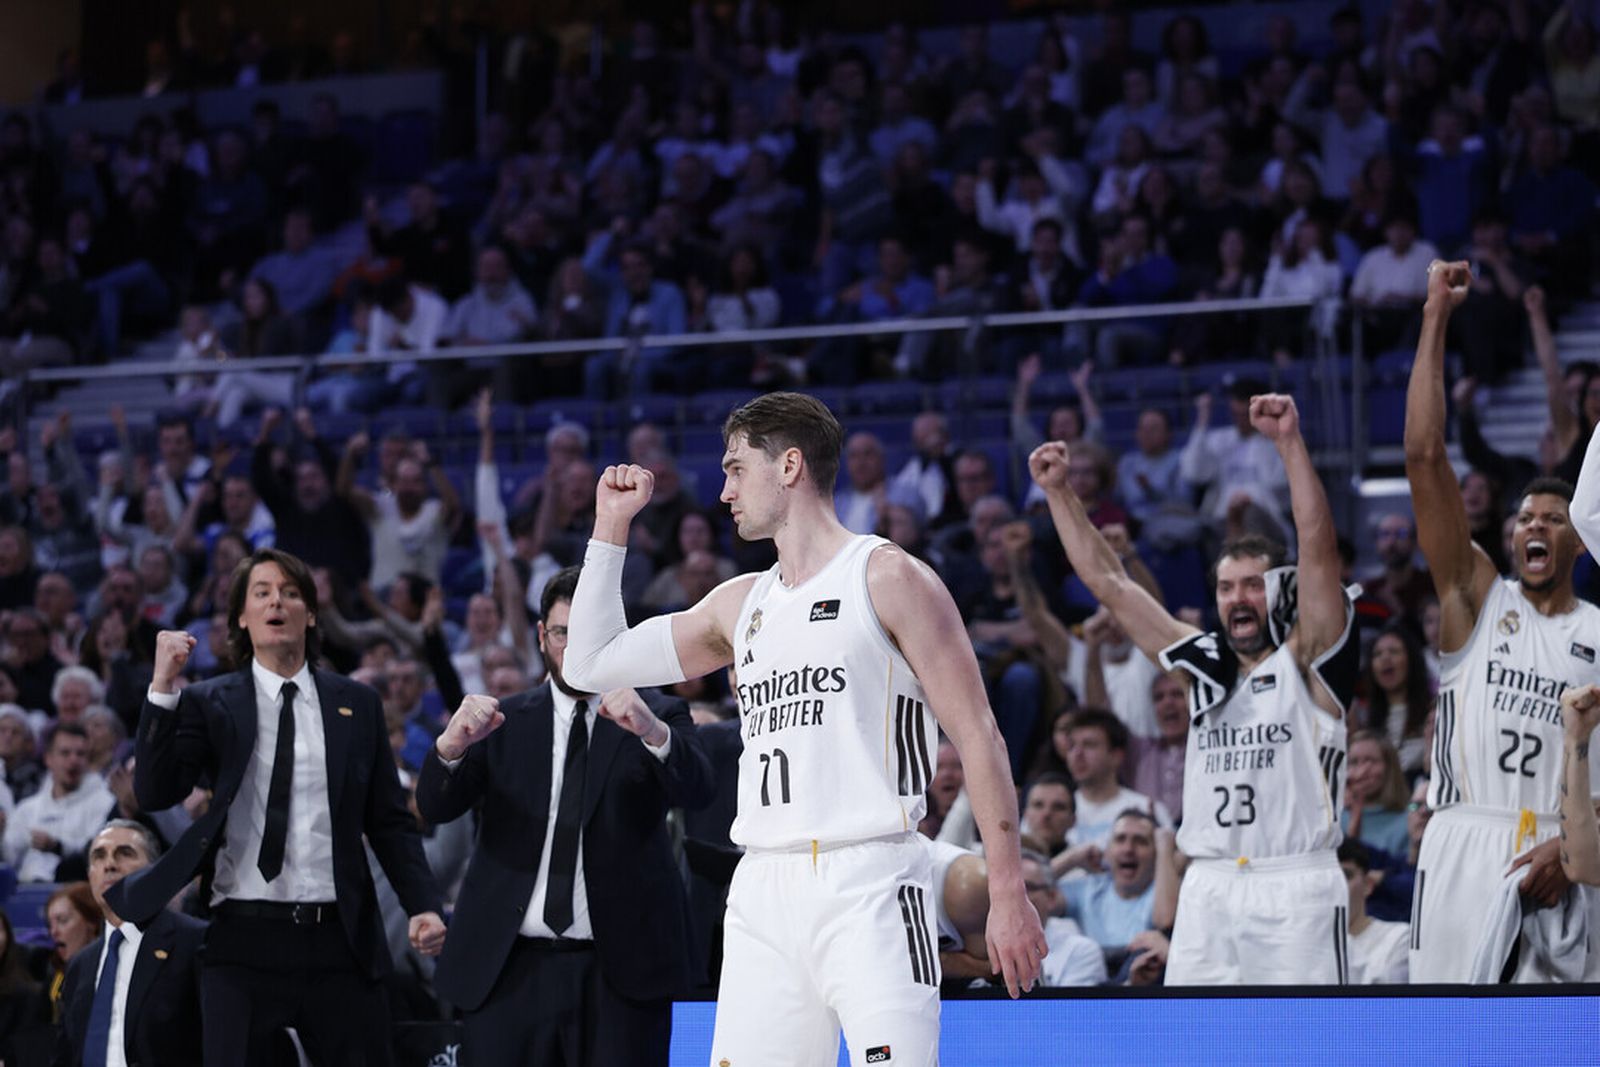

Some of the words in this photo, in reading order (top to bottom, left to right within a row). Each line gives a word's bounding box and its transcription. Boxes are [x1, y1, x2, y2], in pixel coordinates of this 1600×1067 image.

[737, 664, 847, 717] Emirates
[1487, 660, 1577, 701] Emirat
[747, 709, 767, 740] FLY
[769, 699, 825, 733] BETTER
[1493, 691, 1520, 712] FLY
[1520, 697, 1565, 728] BETTE
[1198, 722, 1292, 750] Emirates
[1498, 729, 1543, 779] 22
[1223, 748, 1275, 772] BETTER
[1214, 784, 1256, 828] 23
